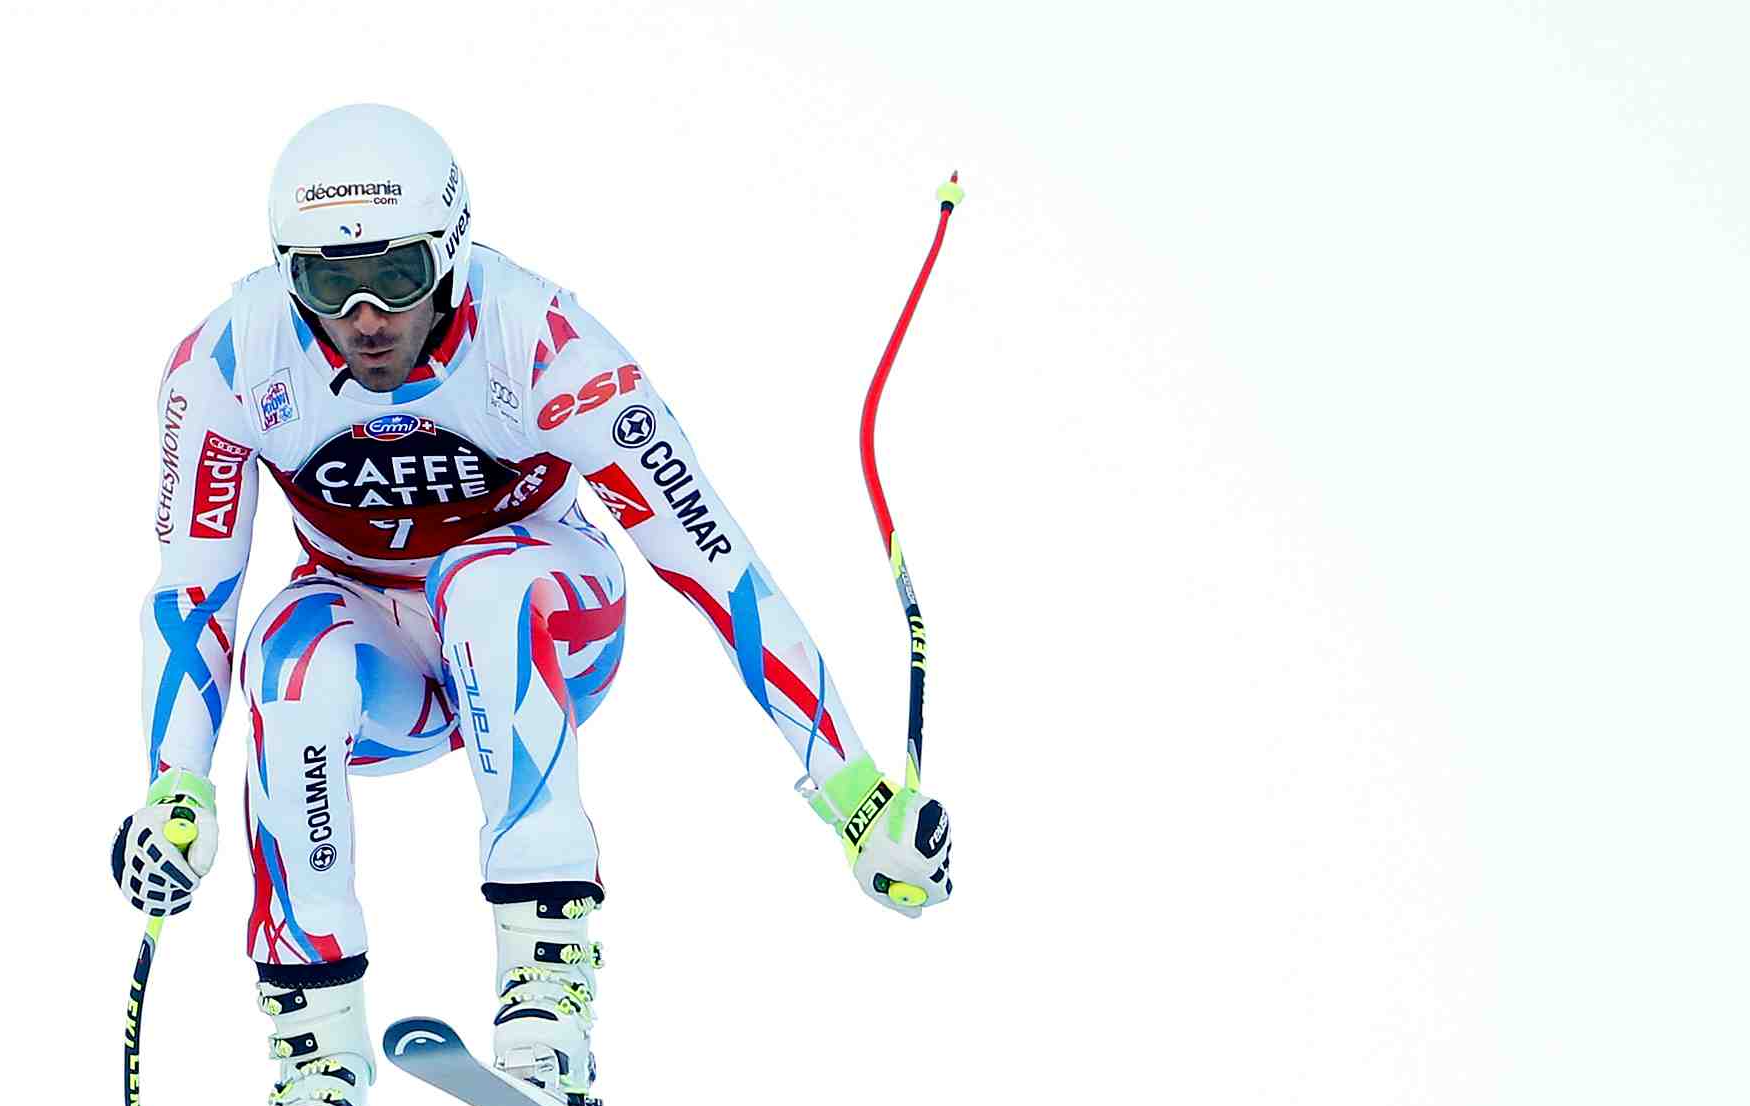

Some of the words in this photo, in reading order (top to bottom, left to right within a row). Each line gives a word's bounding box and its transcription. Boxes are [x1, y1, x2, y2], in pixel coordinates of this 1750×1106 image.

[369, 195, 398, 205] .com
[445, 202, 471, 259] uvex
[369, 420, 415, 433] Emmi
[155, 388, 187, 544] RICHESMONTS
[315, 446, 484, 488] CAFFÈ
[196, 451, 243, 535] Audi
[321, 480, 490, 508] LATTE
[640, 441, 732, 563] COLMAR
[303, 744, 333, 844] COLMAR
[848, 789, 887, 839] LEKI
